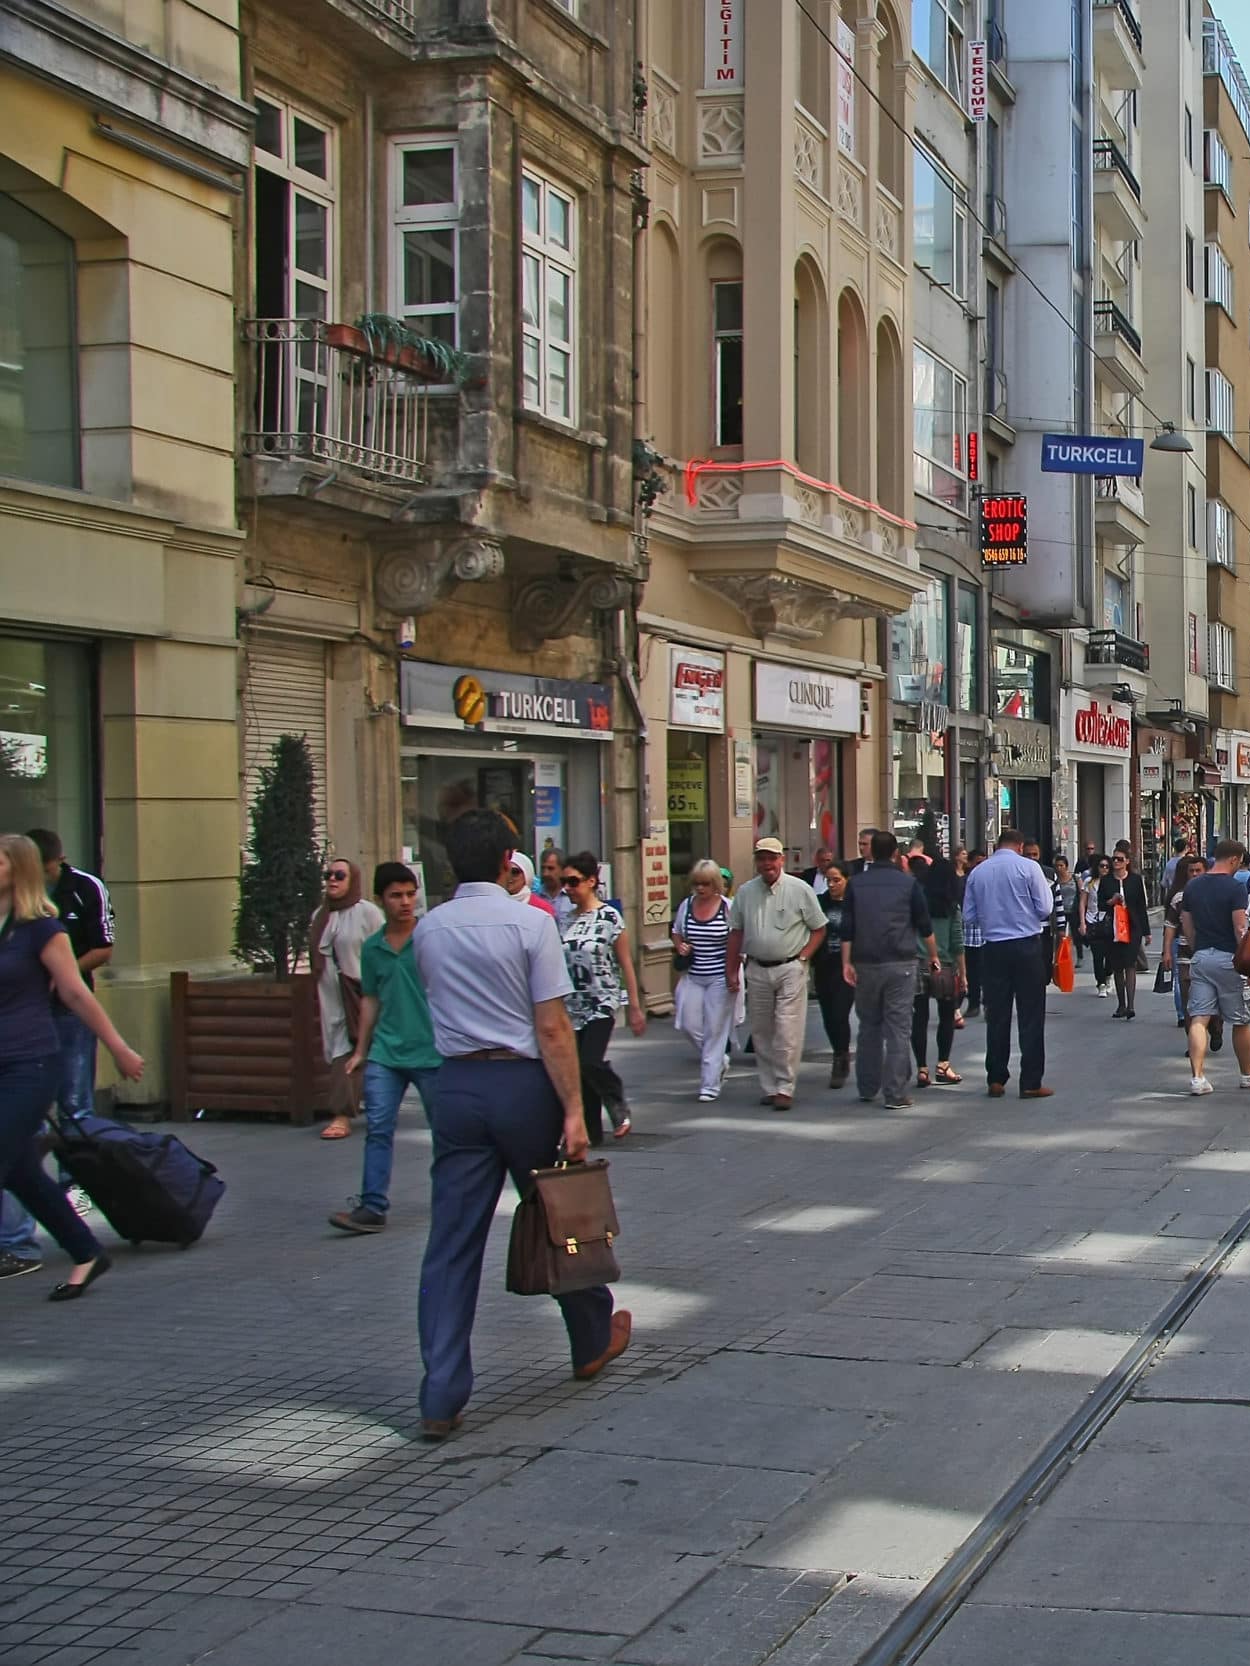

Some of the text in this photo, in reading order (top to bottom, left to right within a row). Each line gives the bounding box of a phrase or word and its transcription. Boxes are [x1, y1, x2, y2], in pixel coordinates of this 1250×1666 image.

[971, 46, 985, 116] TERCÜME
[1047, 445, 1137, 465] TURKCELL
[984, 500, 1024, 518] EROTIC
[988, 523, 1019, 541] SHOP
[788, 679, 834, 711] CLINIQUE
[500, 691, 581, 724] TURKCELL
[668, 794, 686, 811] 65
